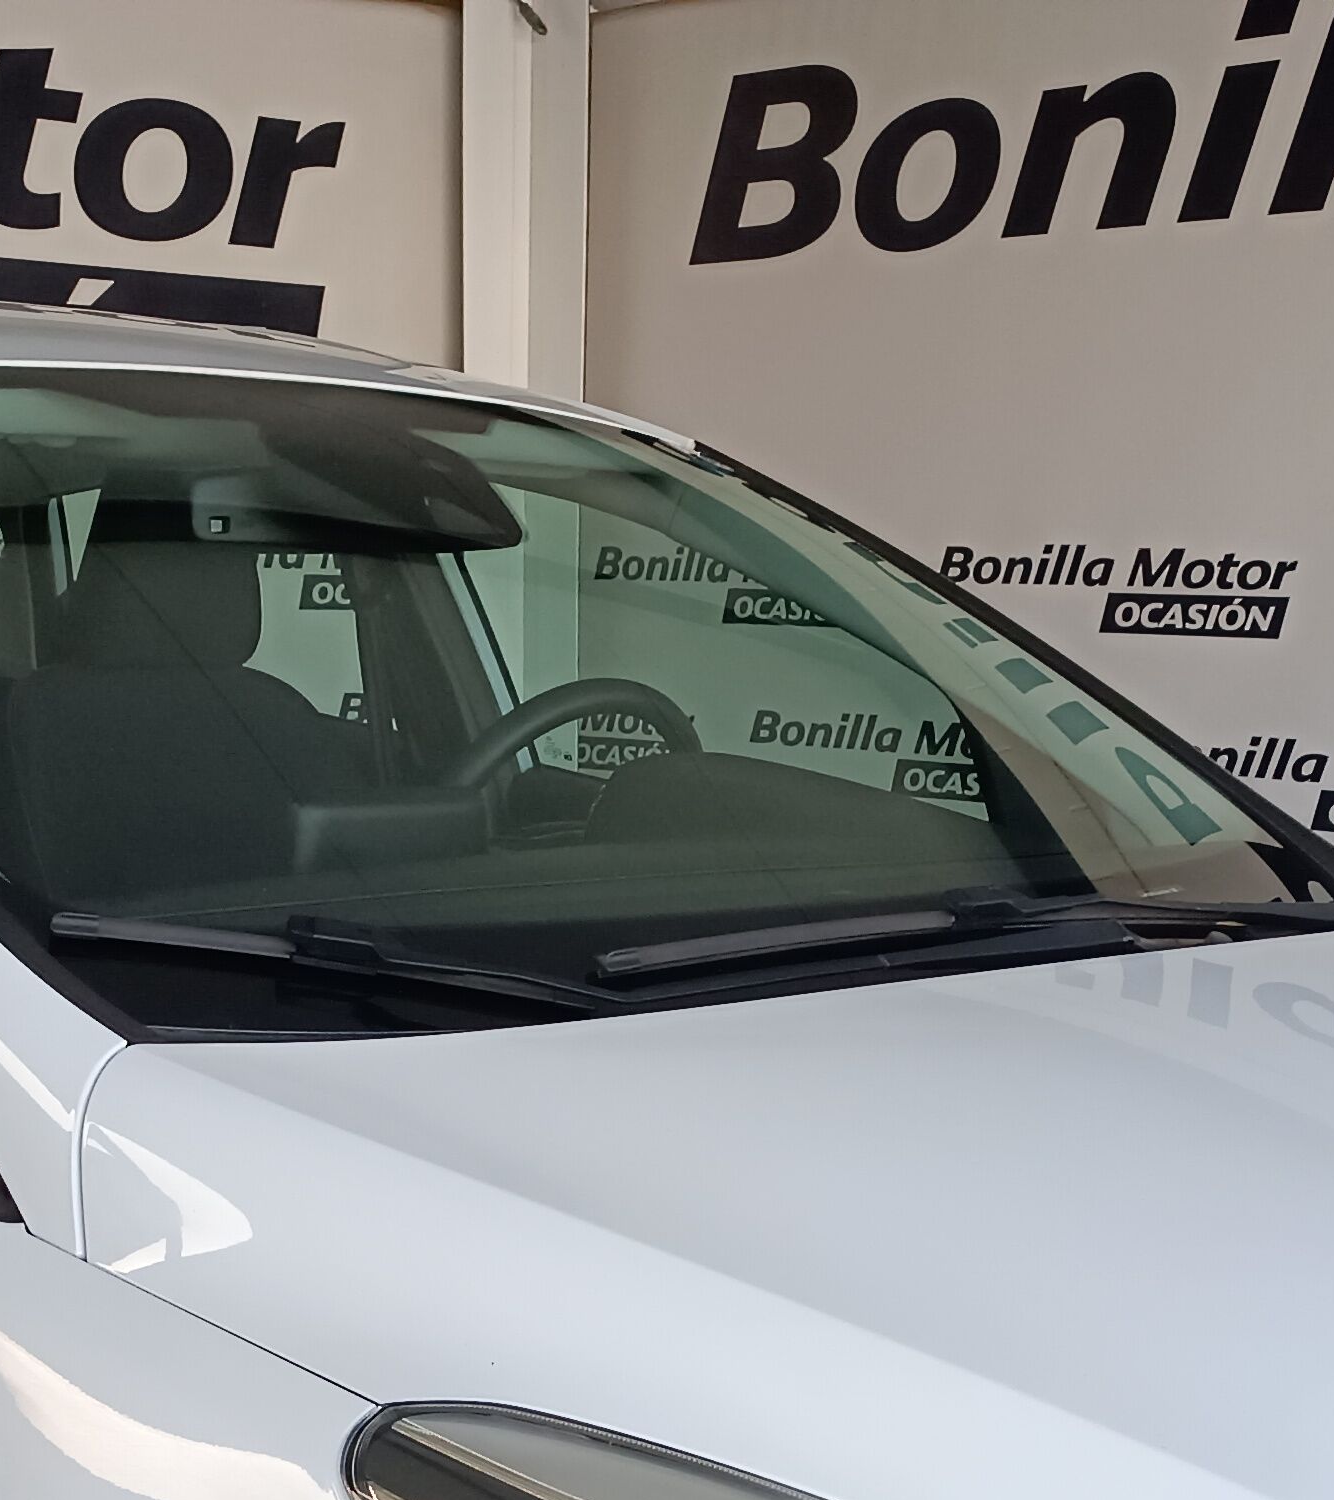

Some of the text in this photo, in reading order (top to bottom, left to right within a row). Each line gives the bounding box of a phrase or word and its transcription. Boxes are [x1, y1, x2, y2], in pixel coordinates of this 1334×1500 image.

[940, 544, 1298, 590] Bonilla Motor
[1114, 598, 1276, 632] OCASIÓN
[749, 709, 902, 753] Bonilla
[1191, 736, 1327, 783] nilla
